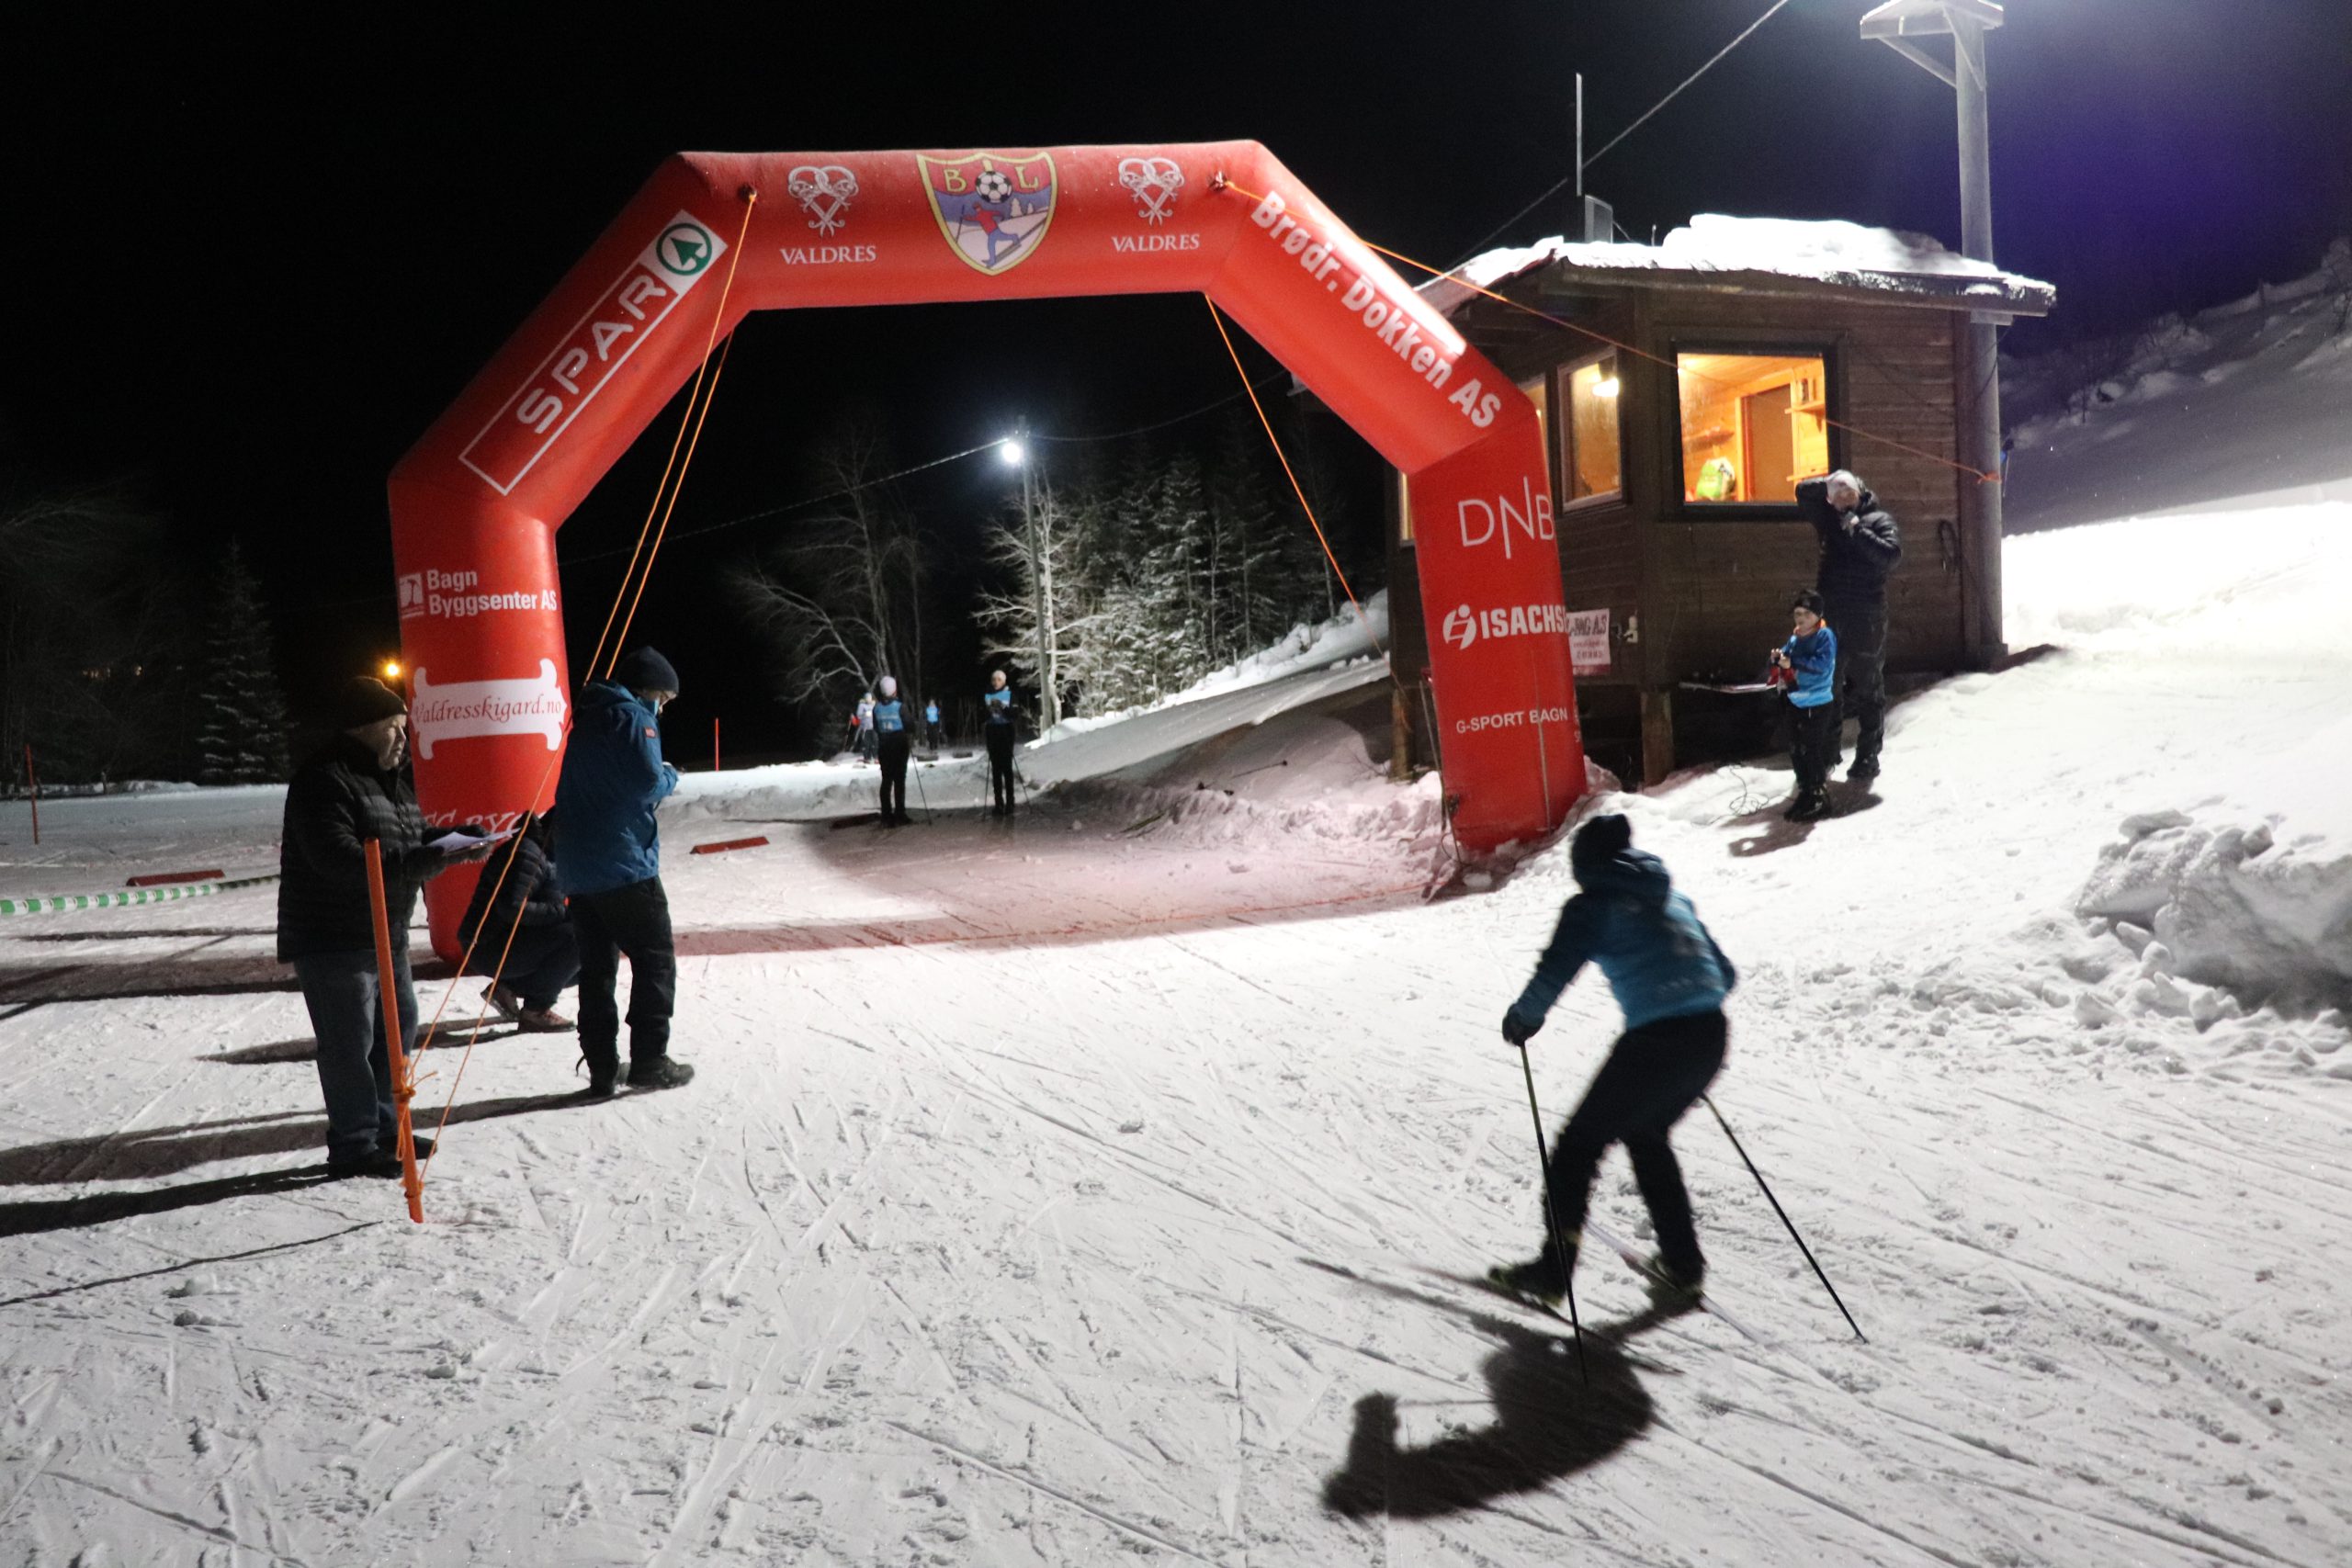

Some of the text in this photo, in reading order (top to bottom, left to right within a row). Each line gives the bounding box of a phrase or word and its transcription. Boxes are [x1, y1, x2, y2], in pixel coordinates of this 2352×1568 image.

[944, 165, 1039, 192] B L
[779, 244, 877, 265] VALDRES
[1111, 233, 1200, 253] VALDRES
[1250, 190, 1501, 427] Brødr. Dokken AS
[516, 276, 667, 434] SPAR
[1457, 476, 1555, 559] DNB
[426, 569, 478, 592] Bagn
[428, 589, 559, 618] Byggsenter AS
[1479, 604, 1567, 640] ISACHS
[1455, 707, 1568, 734] G-SPORT BAGN
